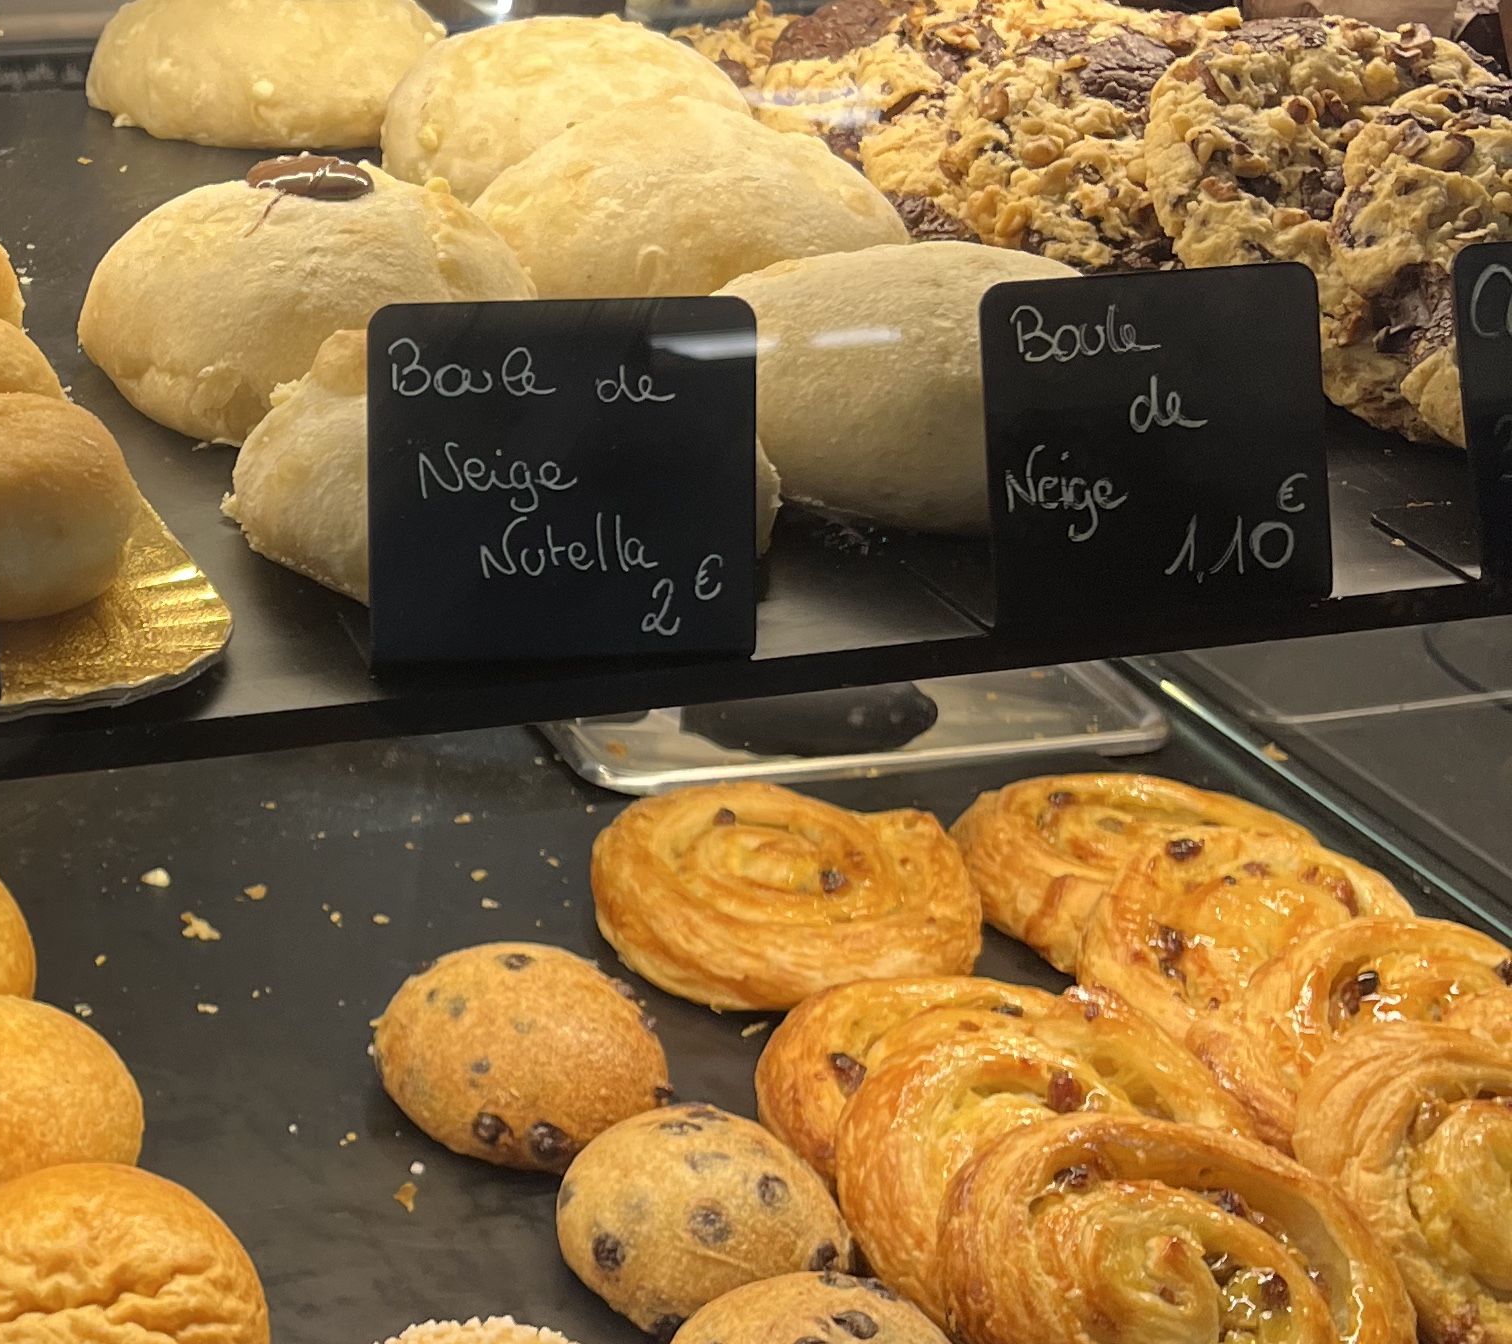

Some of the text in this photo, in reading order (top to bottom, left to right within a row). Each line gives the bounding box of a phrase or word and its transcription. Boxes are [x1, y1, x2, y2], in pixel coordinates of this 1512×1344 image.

[1009, 303, 1161, 363] Boule
[387, 336, 676, 404] Boule de
[1128, 373, 1208, 434] de
[417, 440, 578, 514] Neige
[1004, 443, 1129, 543] Neige
[479, 512, 659, 580] Nutella
